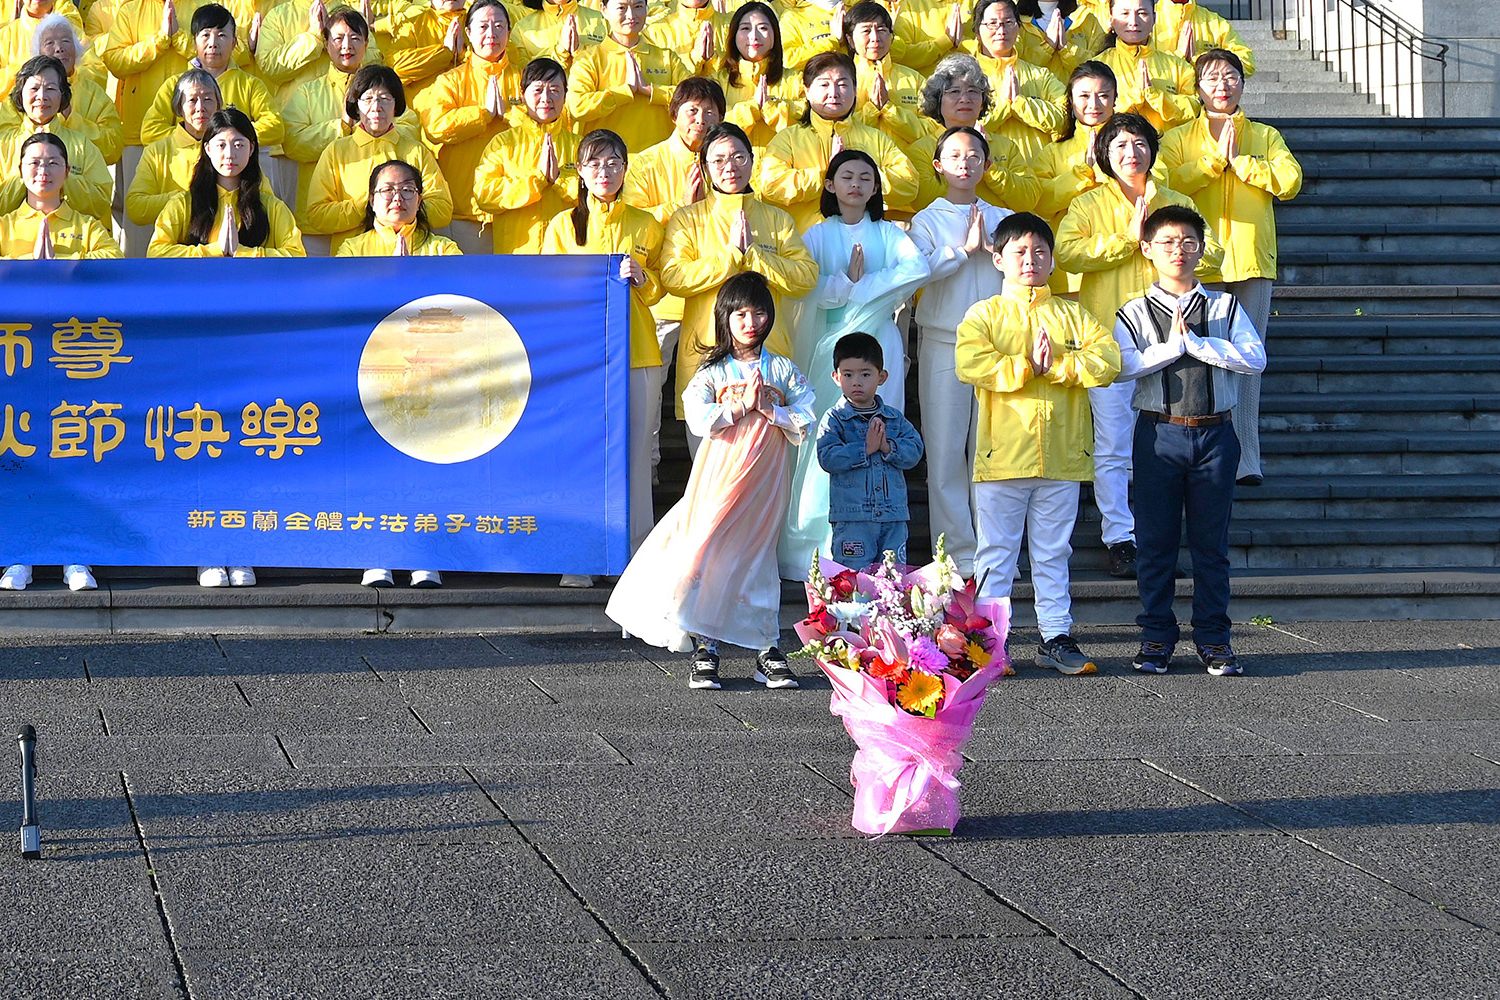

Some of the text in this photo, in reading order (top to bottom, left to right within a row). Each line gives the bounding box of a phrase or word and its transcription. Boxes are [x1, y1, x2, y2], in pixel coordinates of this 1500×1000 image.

[187, 509, 539, 535] 新西蘭全體大法弟子敬拜
